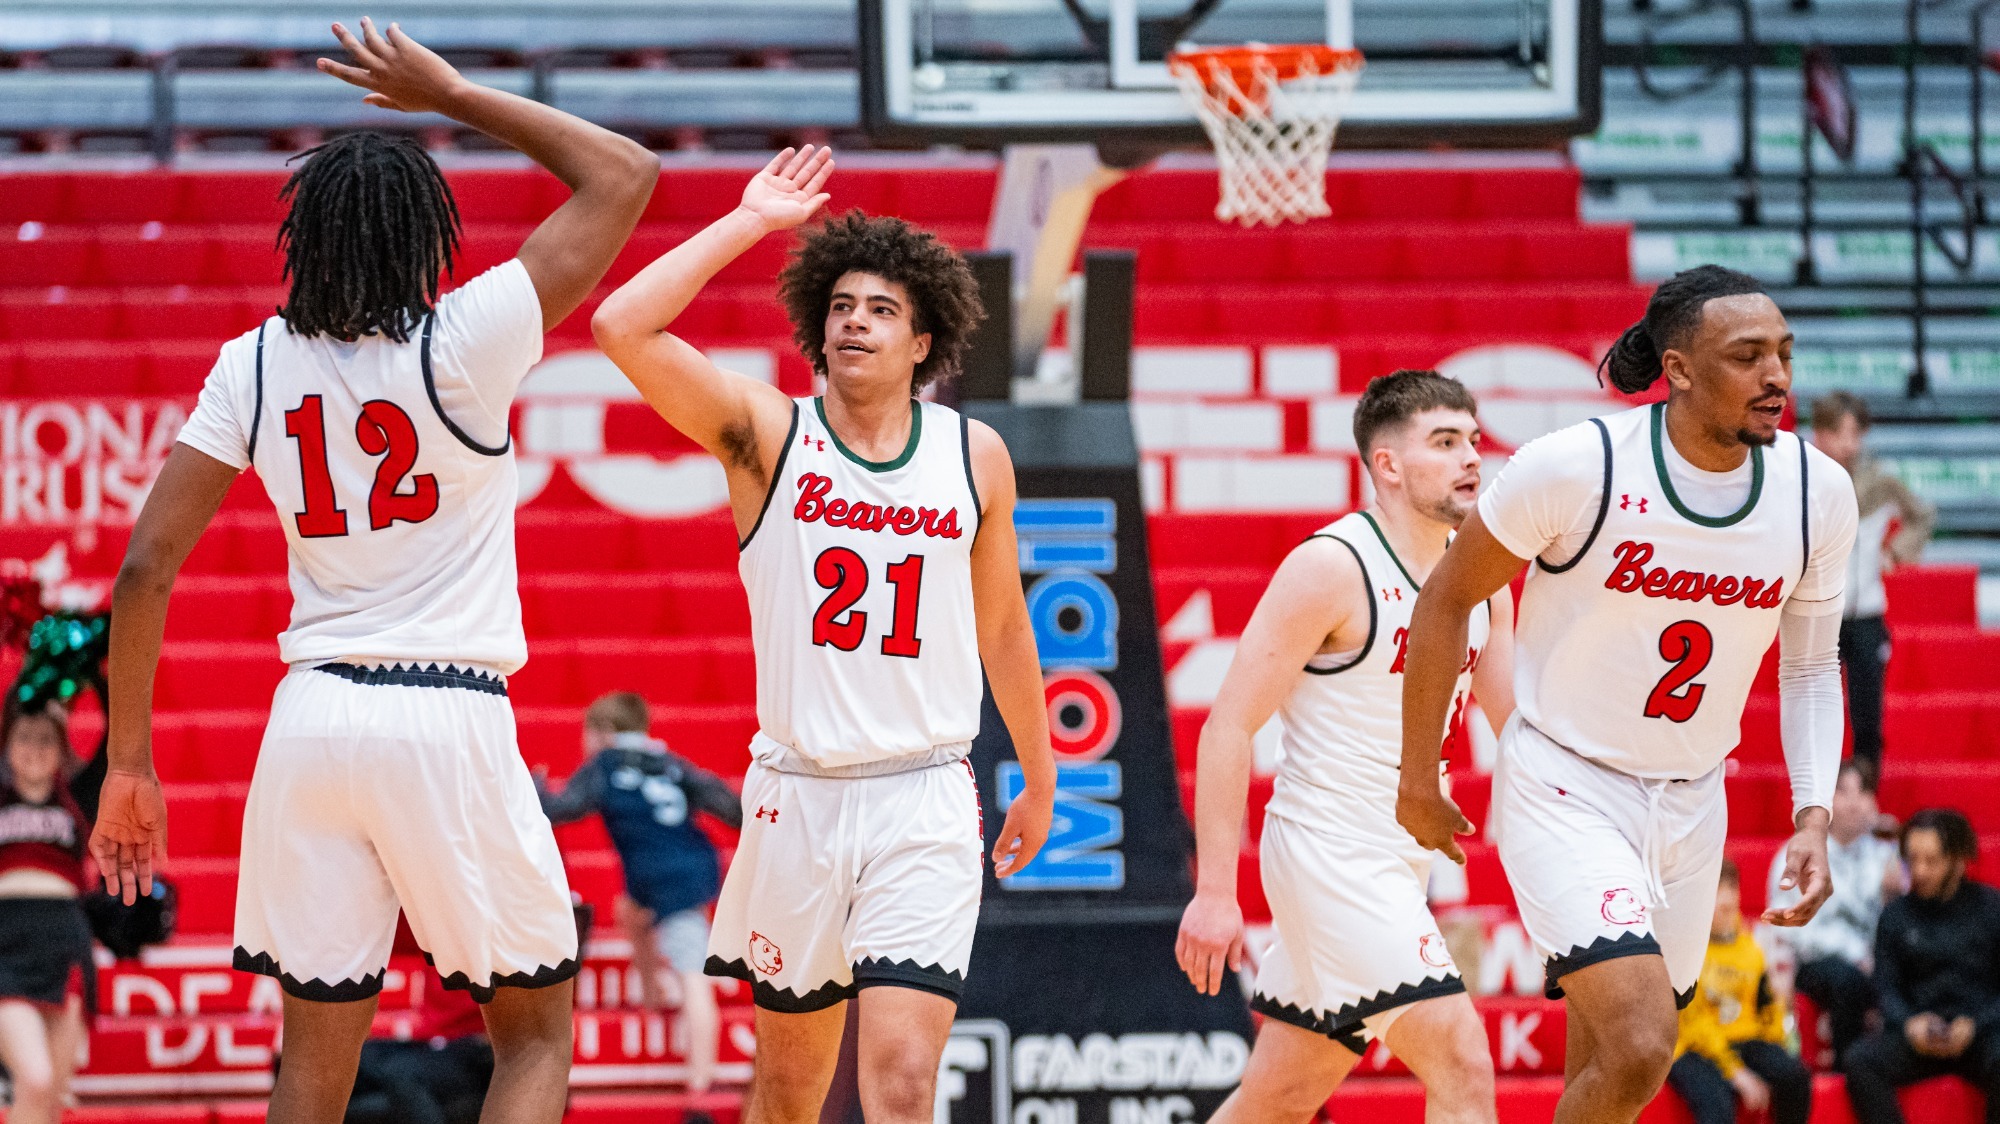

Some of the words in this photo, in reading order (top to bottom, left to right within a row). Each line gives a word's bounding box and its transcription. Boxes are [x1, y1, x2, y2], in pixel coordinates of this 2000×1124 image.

[285, 394, 439, 538] 12
[794, 472, 963, 540] Beavers
[812, 546, 925, 659] 21
[1604, 540, 1784, 609] Beavers
[1643, 619, 1713, 723] 2
[1012, 1030, 1250, 1093] FARSTAD
